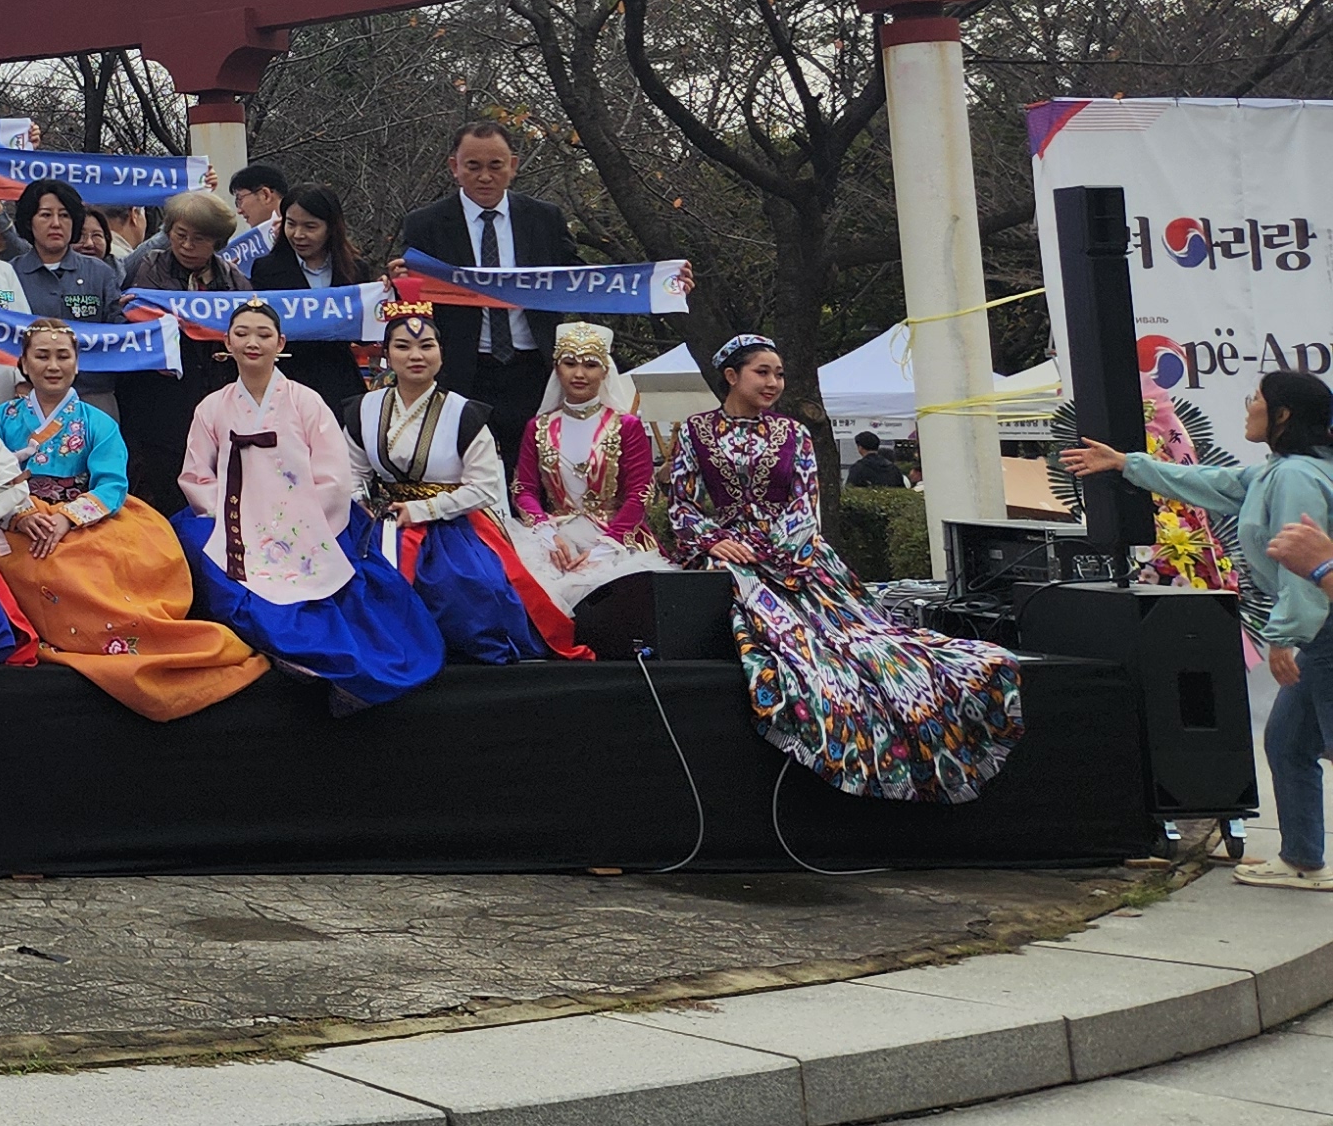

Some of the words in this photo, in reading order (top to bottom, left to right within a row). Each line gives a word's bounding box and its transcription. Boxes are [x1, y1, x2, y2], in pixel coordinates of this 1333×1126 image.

[10, 160, 101, 184] КОРЕЯ
[113, 166, 178, 190] УРА!
[230, 234, 265, 265] УРА!
[451, 270, 553, 291] КОРЕЯ
[566, 270, 641, 296] УРА!
[281, 295, 353, 320] УРА!
[1135, 316, 1169, 324] иваль
[80, 328, 153, 353] УРА!
